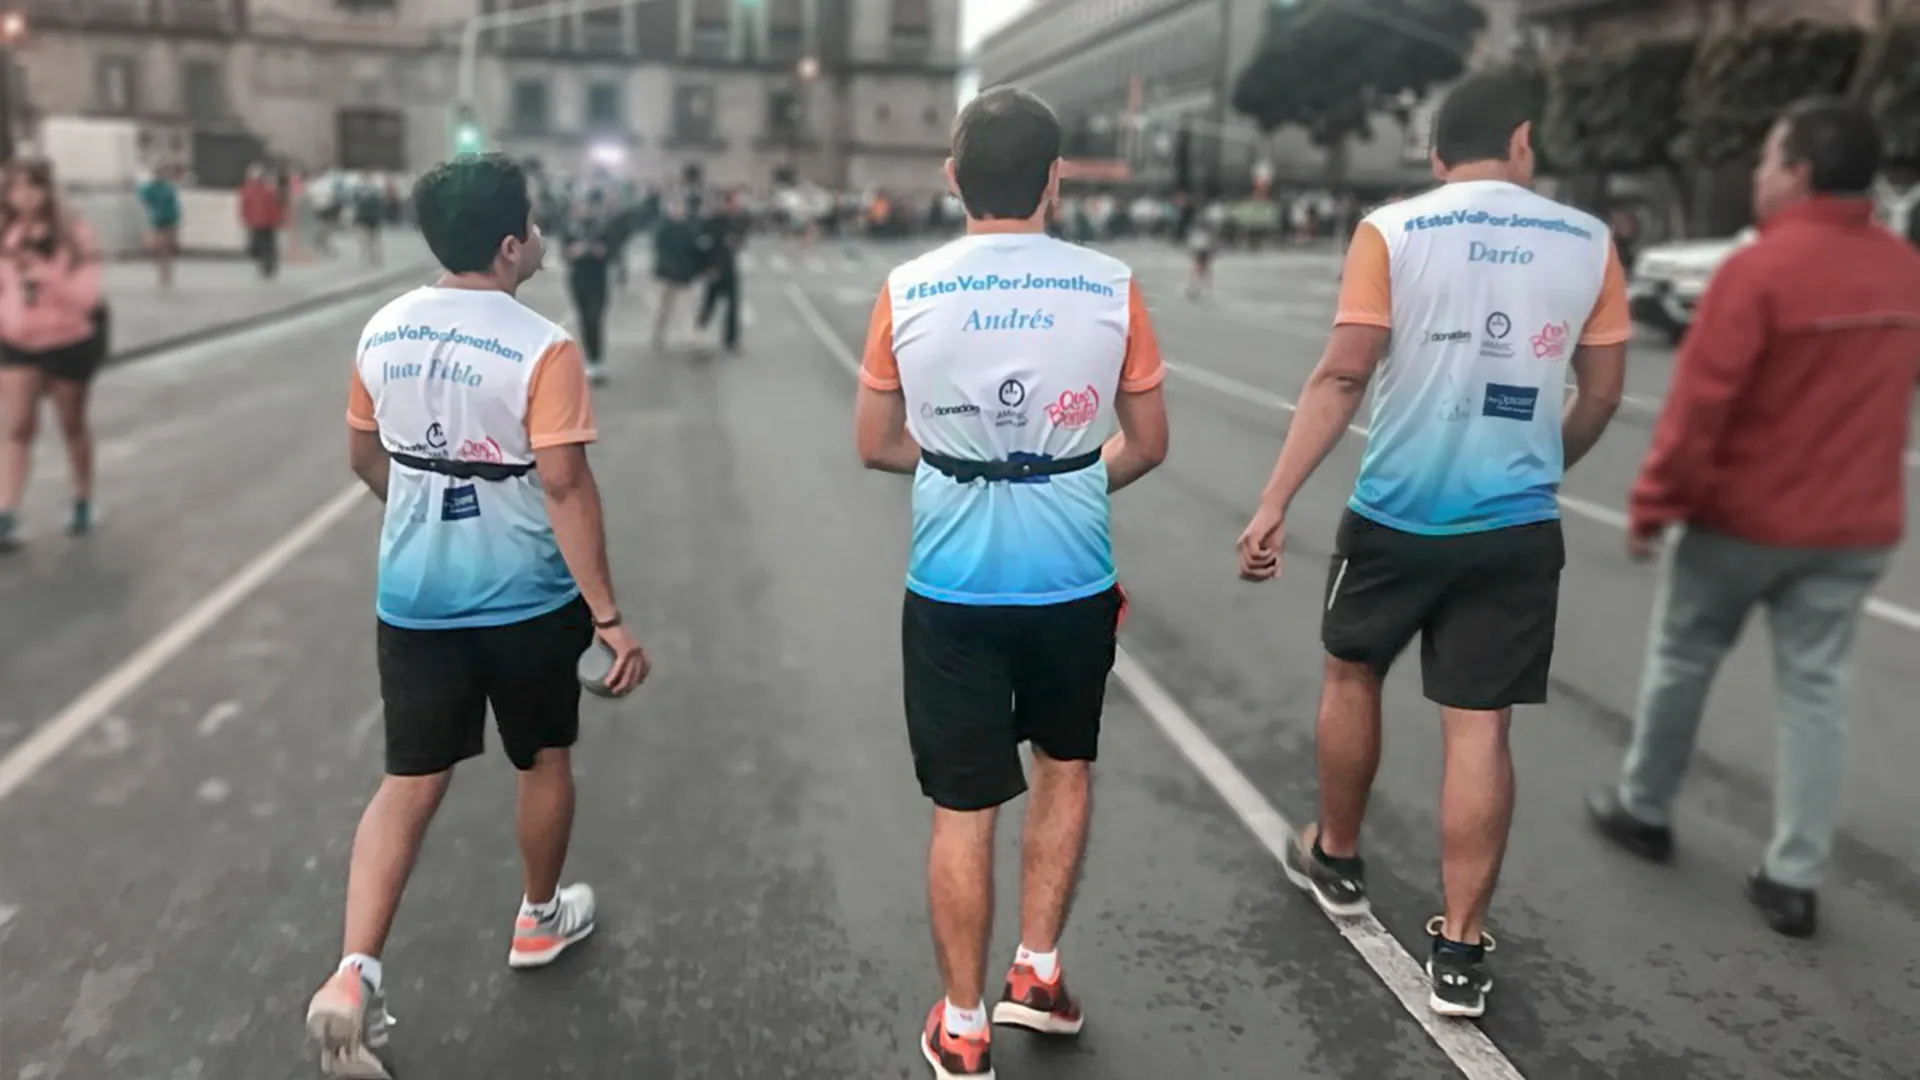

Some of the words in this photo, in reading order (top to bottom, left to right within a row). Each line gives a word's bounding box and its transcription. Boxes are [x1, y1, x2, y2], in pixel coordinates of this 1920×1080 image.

[1468, 241, 1534, 264] Darío
[906, 273, 1114, 300] #EstaVaPorJonathan
[961, 308, 1055, 331] Andrés
